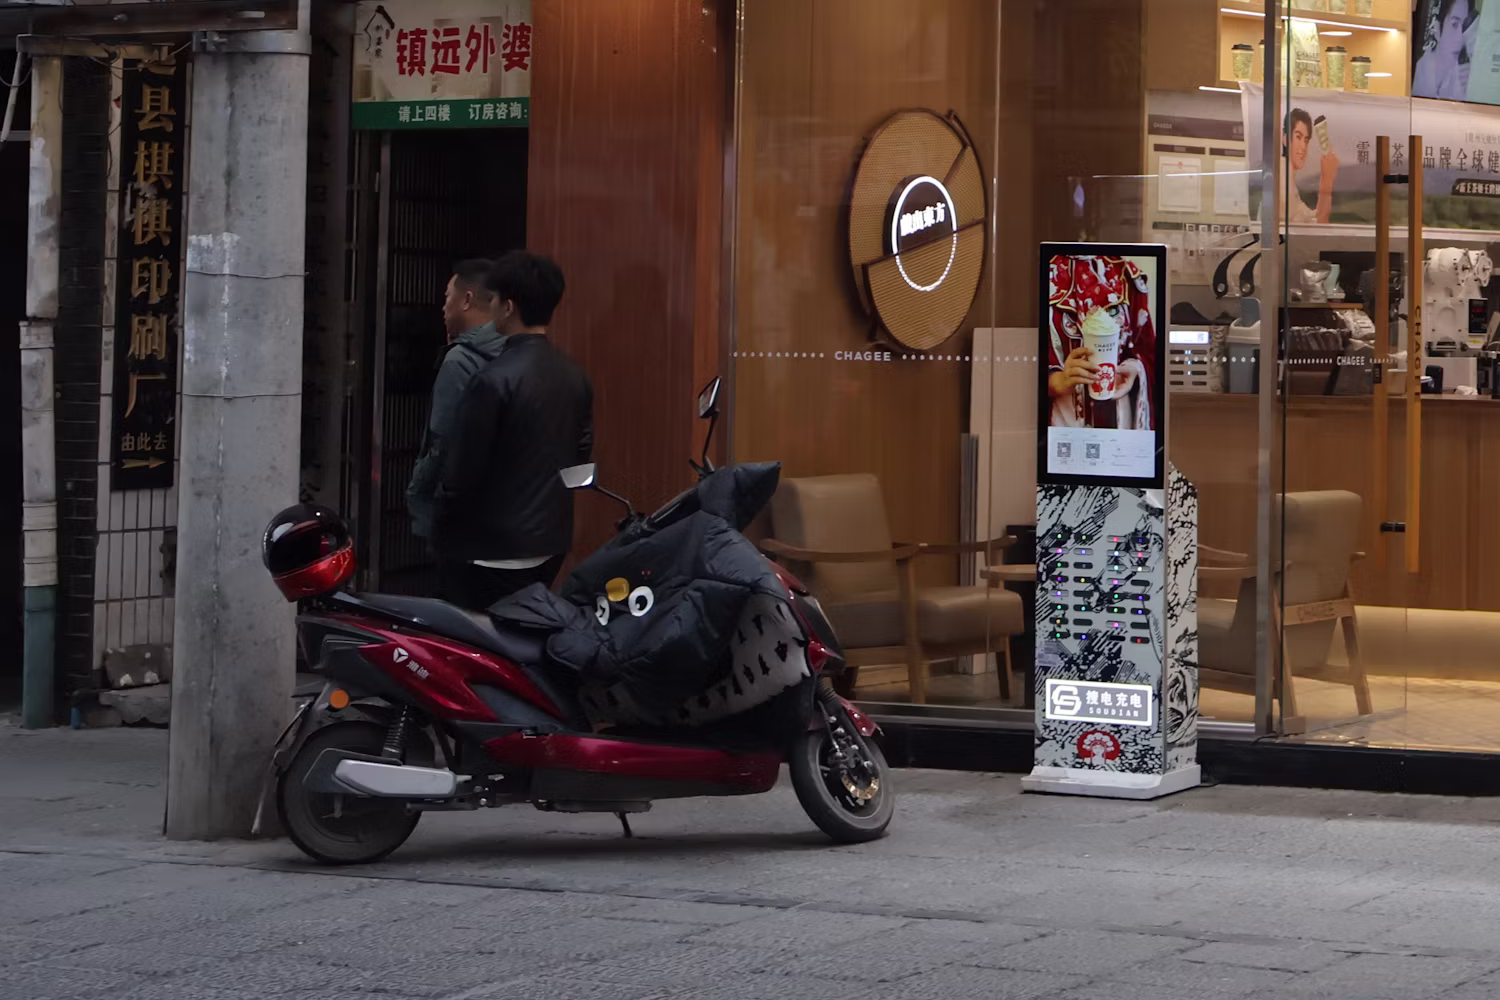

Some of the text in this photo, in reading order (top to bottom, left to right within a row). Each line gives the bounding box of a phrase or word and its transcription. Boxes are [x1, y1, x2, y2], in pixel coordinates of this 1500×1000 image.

[396, 22, 532, 77] 镇远外婆
[398, 104, 450, 123] 请上四楼
[834, 350, 892, 361] CHAGEE
[1336, 355, 1365, 366] CHAGEE
[120, 431, 168, 452] 由此去
[1085, 690, 1143, 708] 搜电充电
[1089, 707, 1139, 718] SOUDIAN
